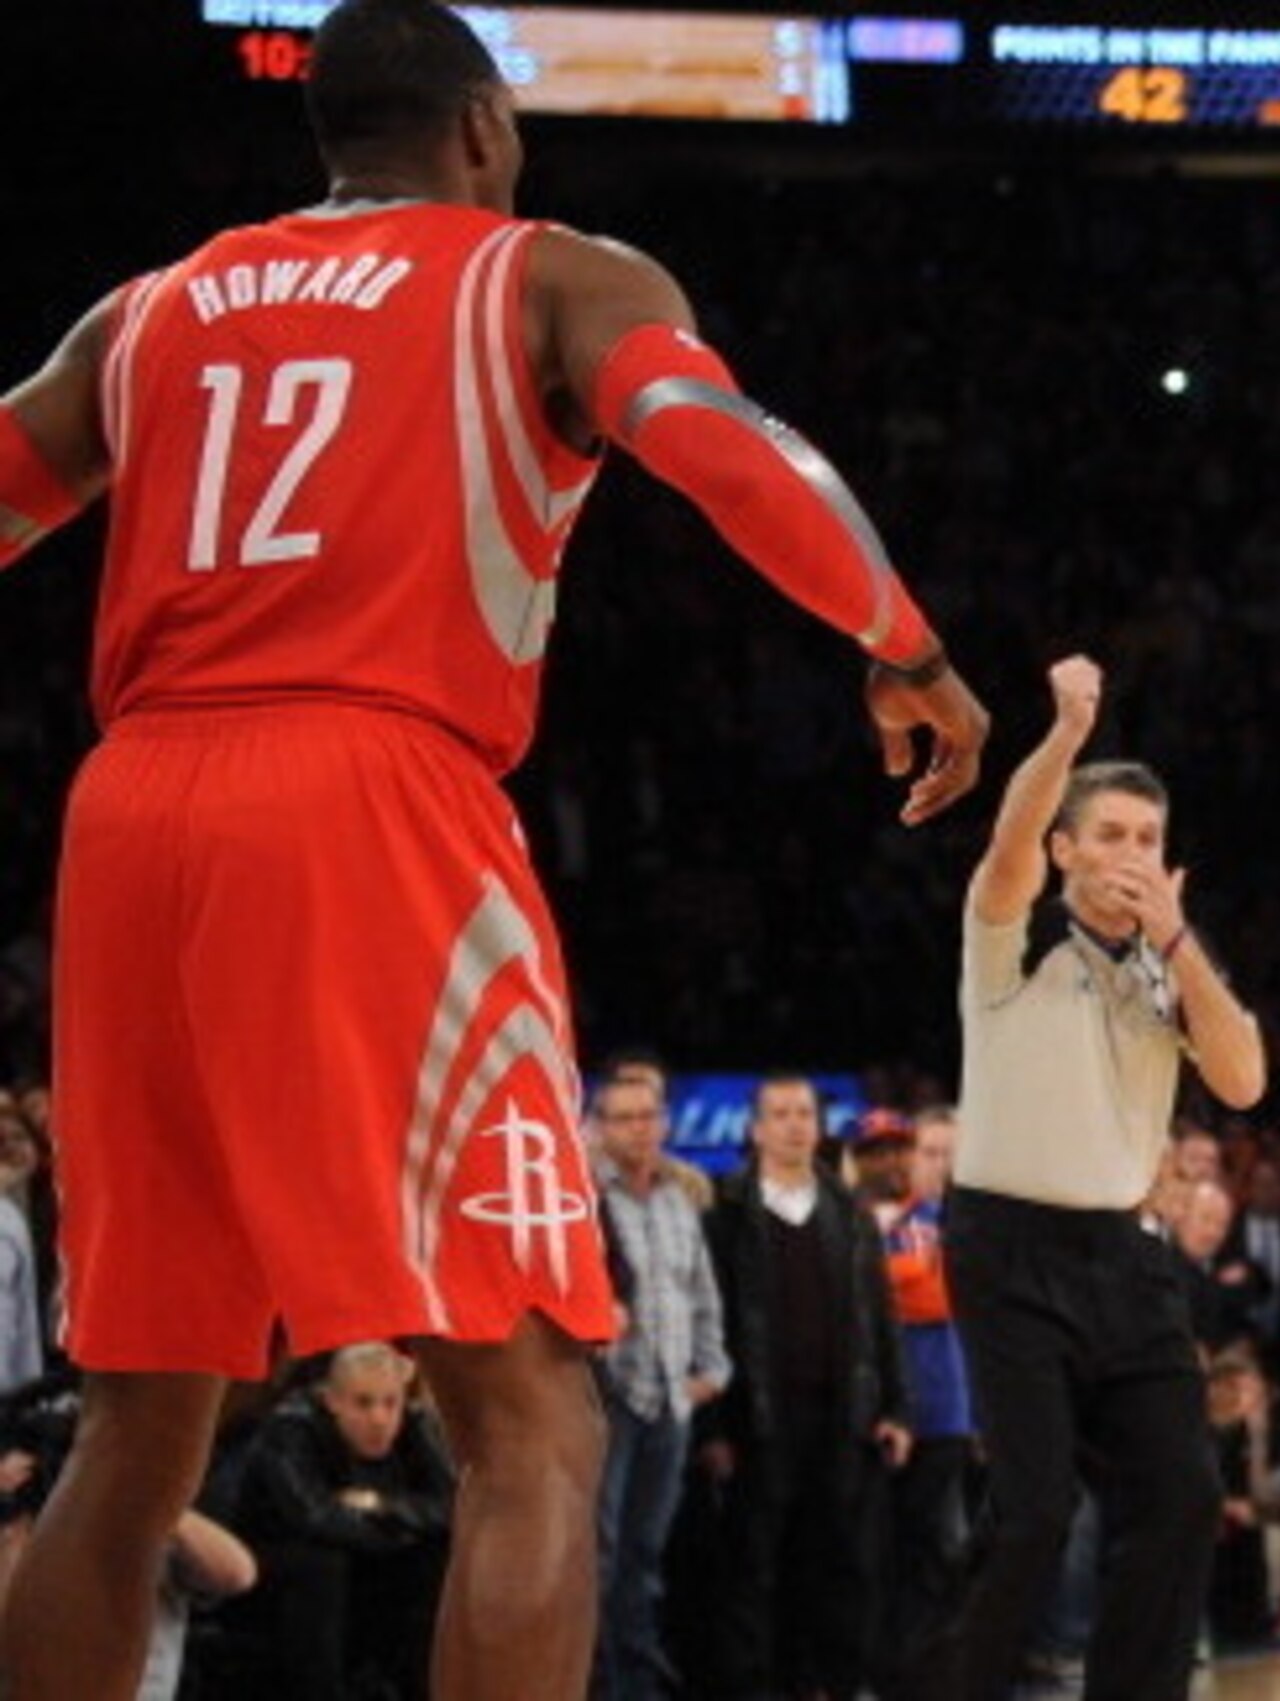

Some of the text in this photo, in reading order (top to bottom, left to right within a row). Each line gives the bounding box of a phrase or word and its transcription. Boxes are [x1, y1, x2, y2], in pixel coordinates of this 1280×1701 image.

[993, 26, 1102, 63] POINTS
[1100, 67, 1187, 122] 42
[188, 253, 413, 326] HOWARD
[188, 357, 353, 571] 12
